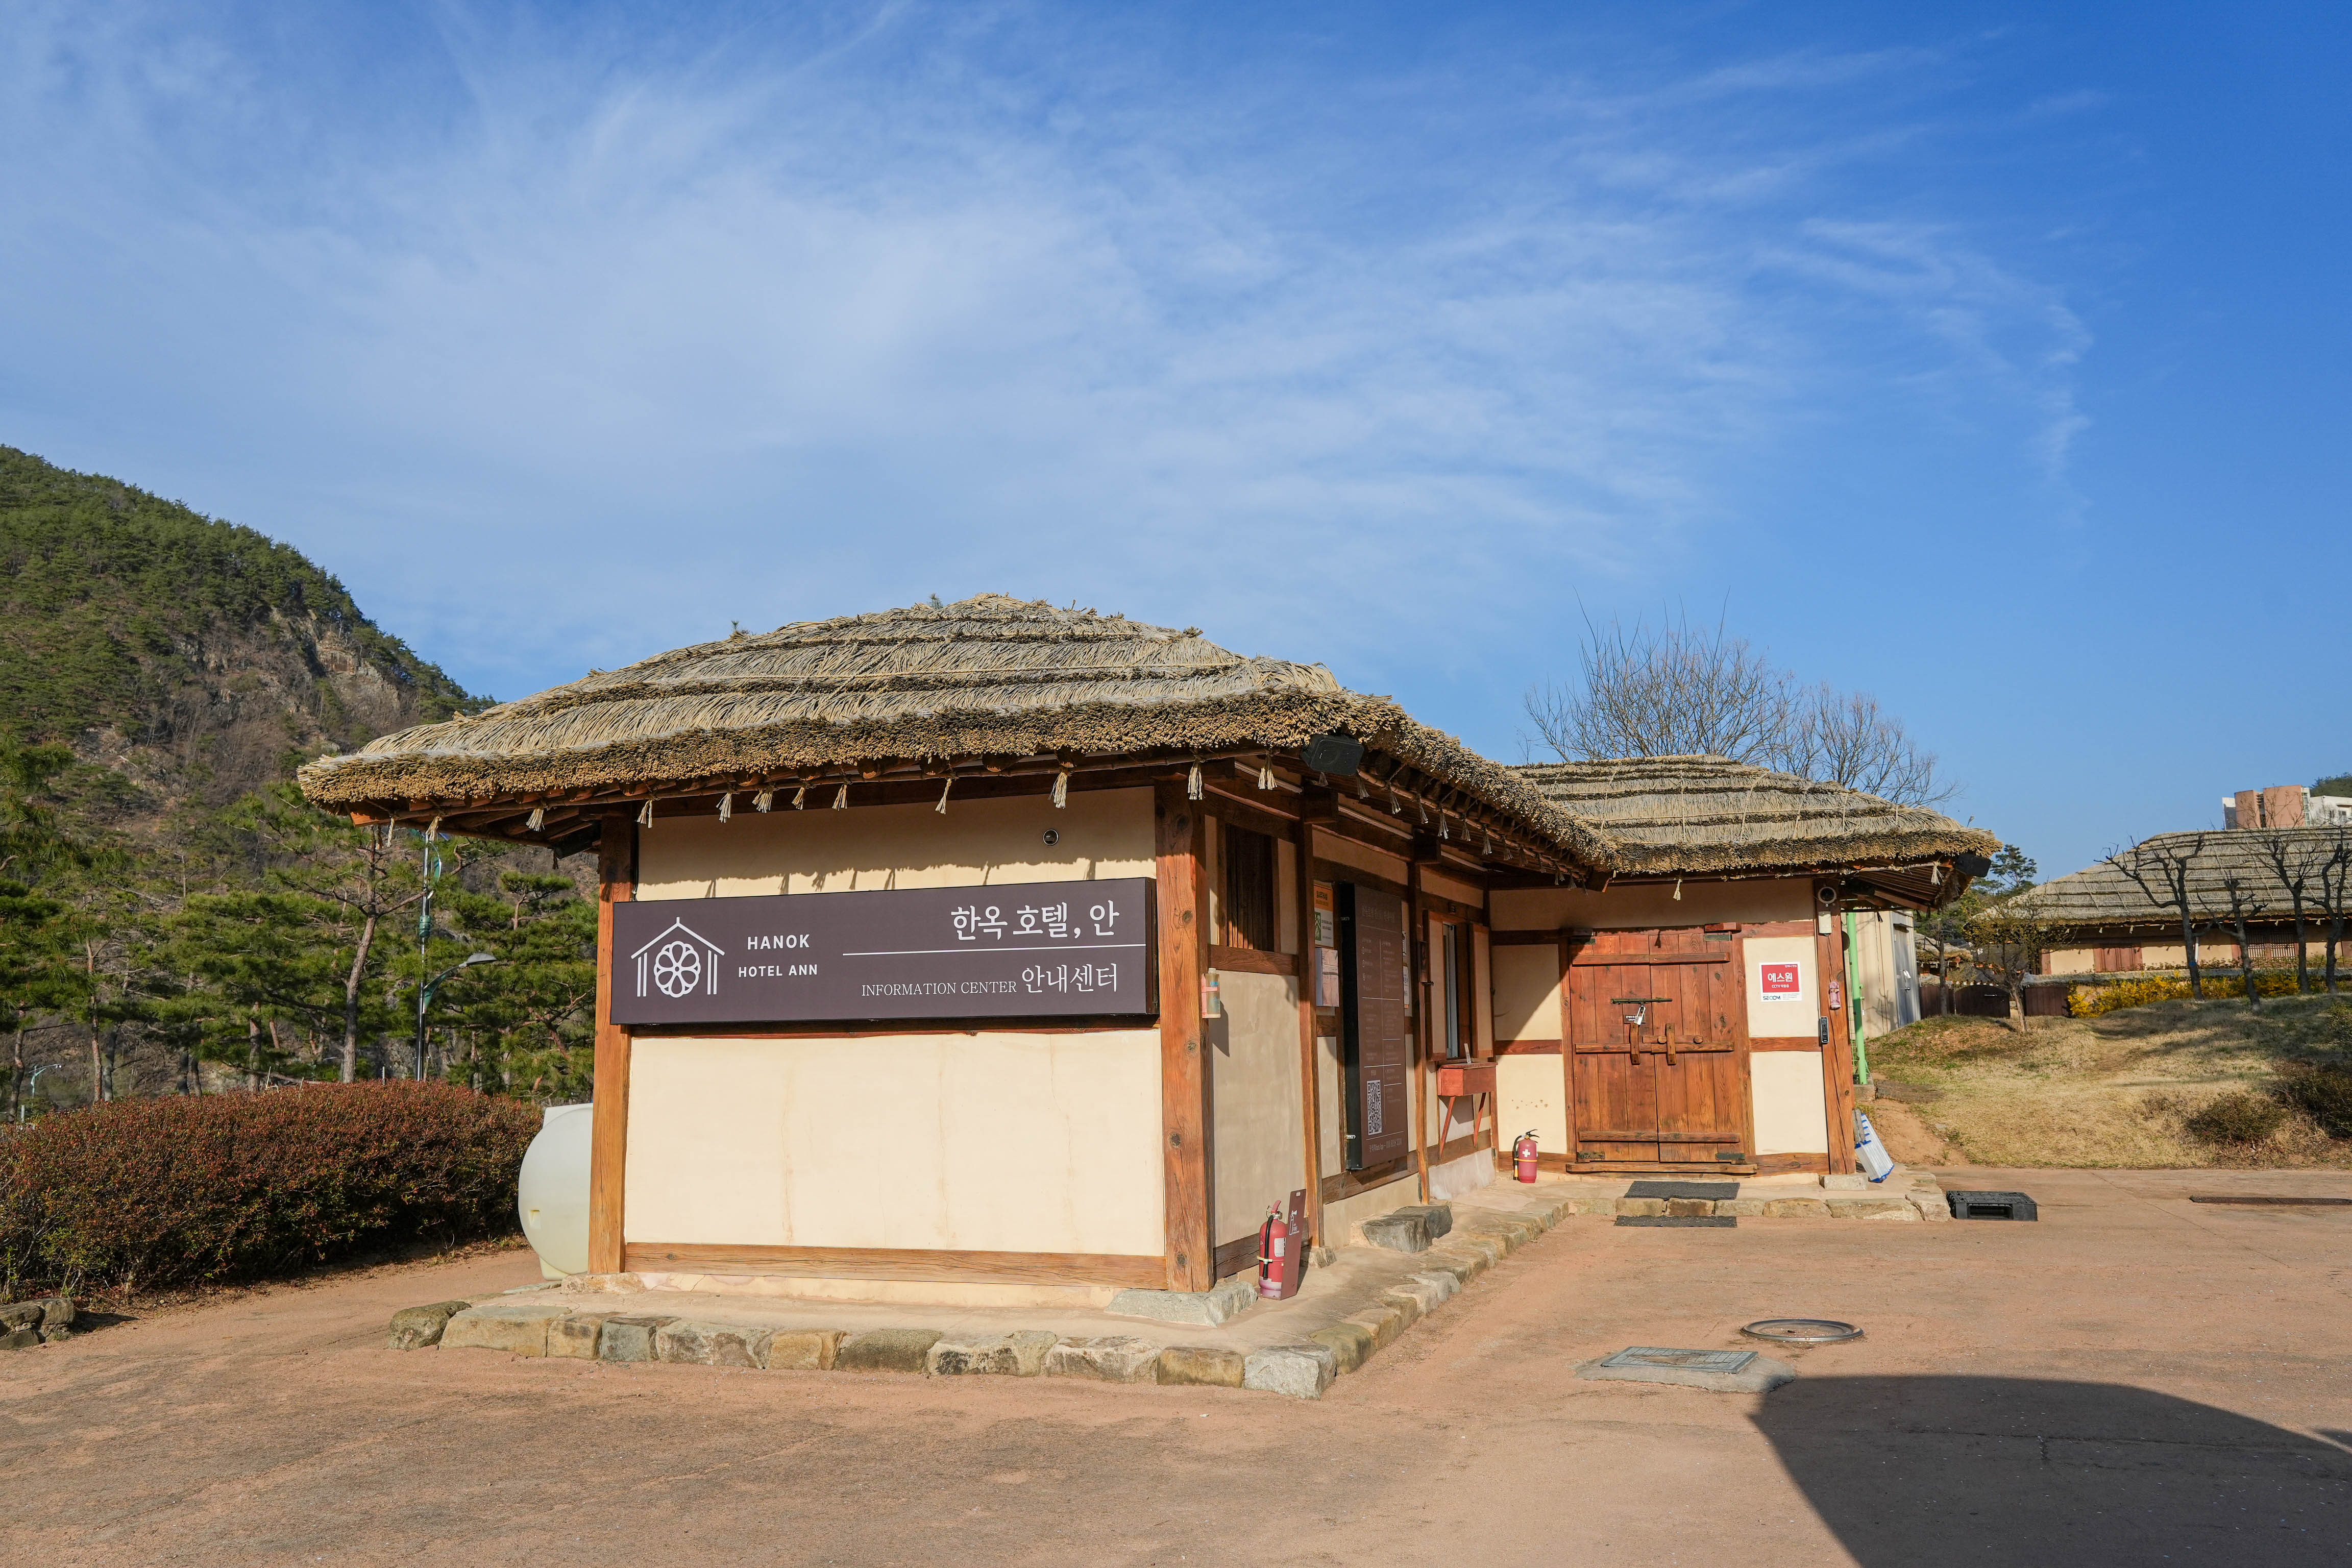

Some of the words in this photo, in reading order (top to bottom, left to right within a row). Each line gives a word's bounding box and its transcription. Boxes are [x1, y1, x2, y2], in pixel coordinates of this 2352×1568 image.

[951, 905, 1008, 940] 한옥
[1013, 901, 1082, 939] 호텔,
[1089, 899, 1120, 936] 안
[747, 934, 810, 950] HANOK
[738, 965, 783, 977] HOTEL
[788, 964, 817, 976] ANN
[1021, 963, 1117, 993] 안내센터
[1768, 972, 1793, 983] 에스원
[861, 983, 957, 996] INFORMATION
[961, 981, 1017, 994] CENTER
